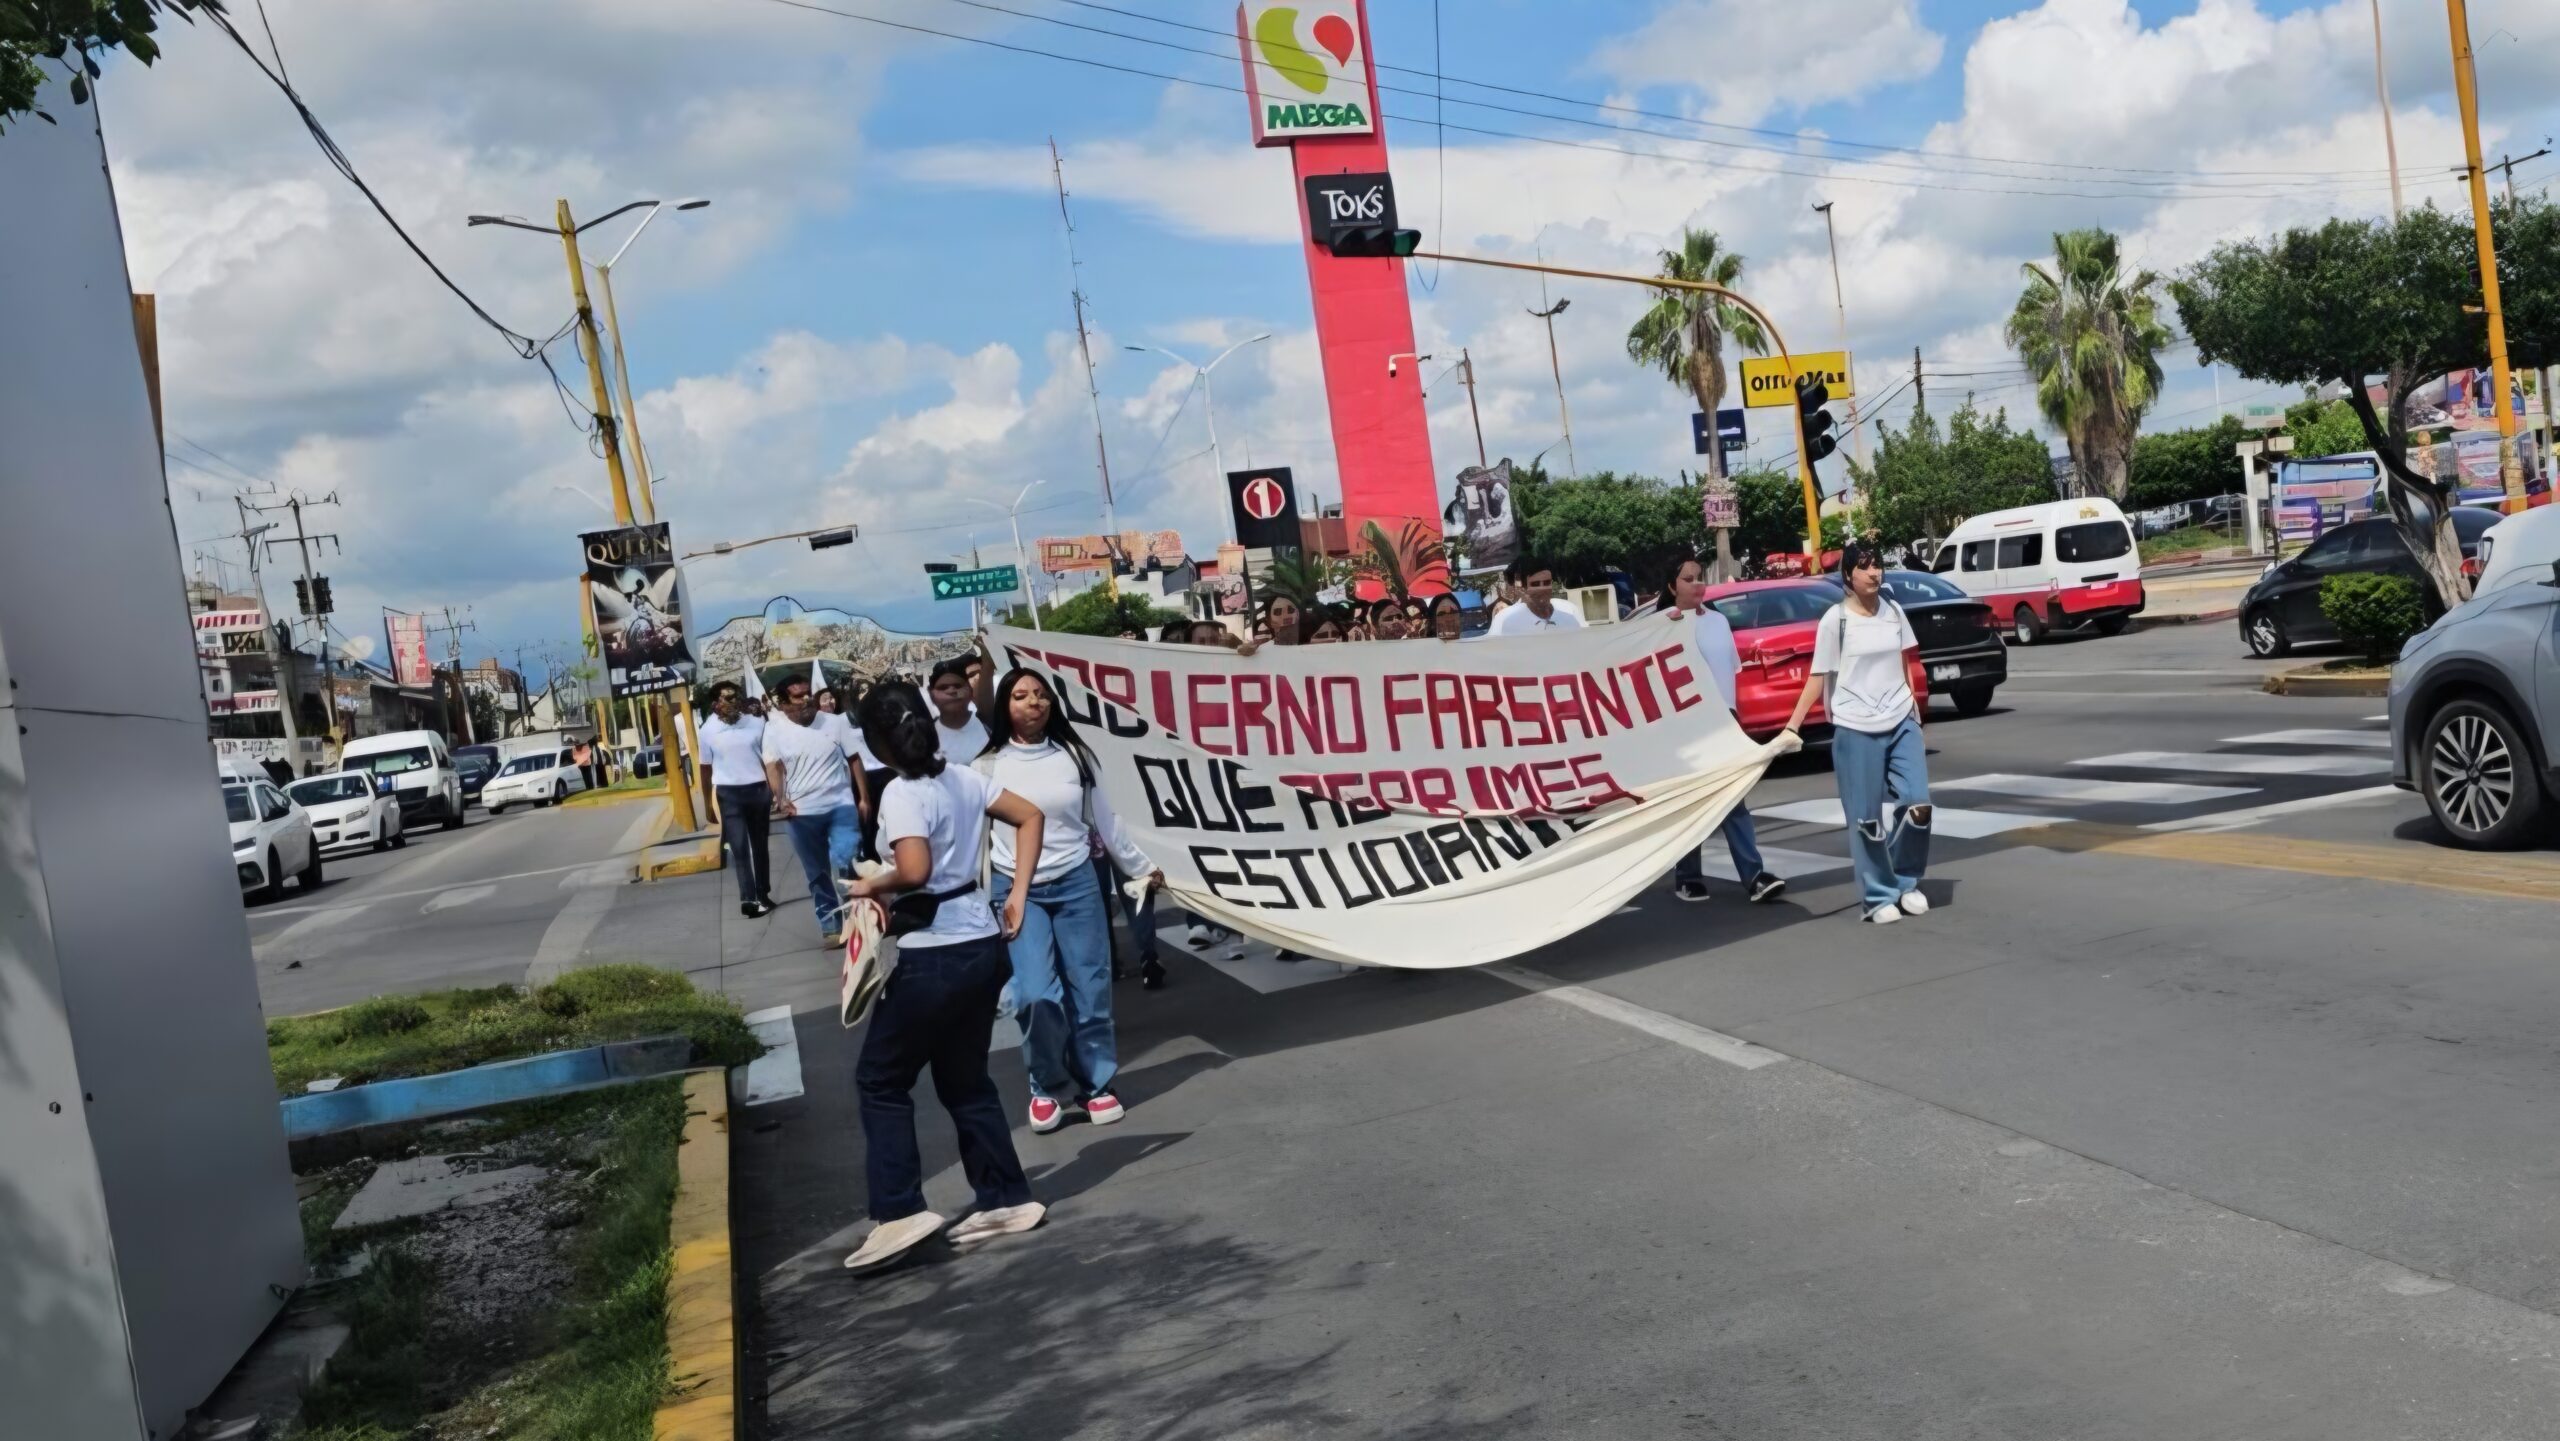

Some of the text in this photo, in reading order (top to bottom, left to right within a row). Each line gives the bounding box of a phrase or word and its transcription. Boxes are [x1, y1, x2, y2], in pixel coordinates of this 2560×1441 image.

[1267, 103, 1367, 129] MEGA
[1383, 643, 1703, 752] FARSANTE
[1133, 754, 1285, 833] QUE
